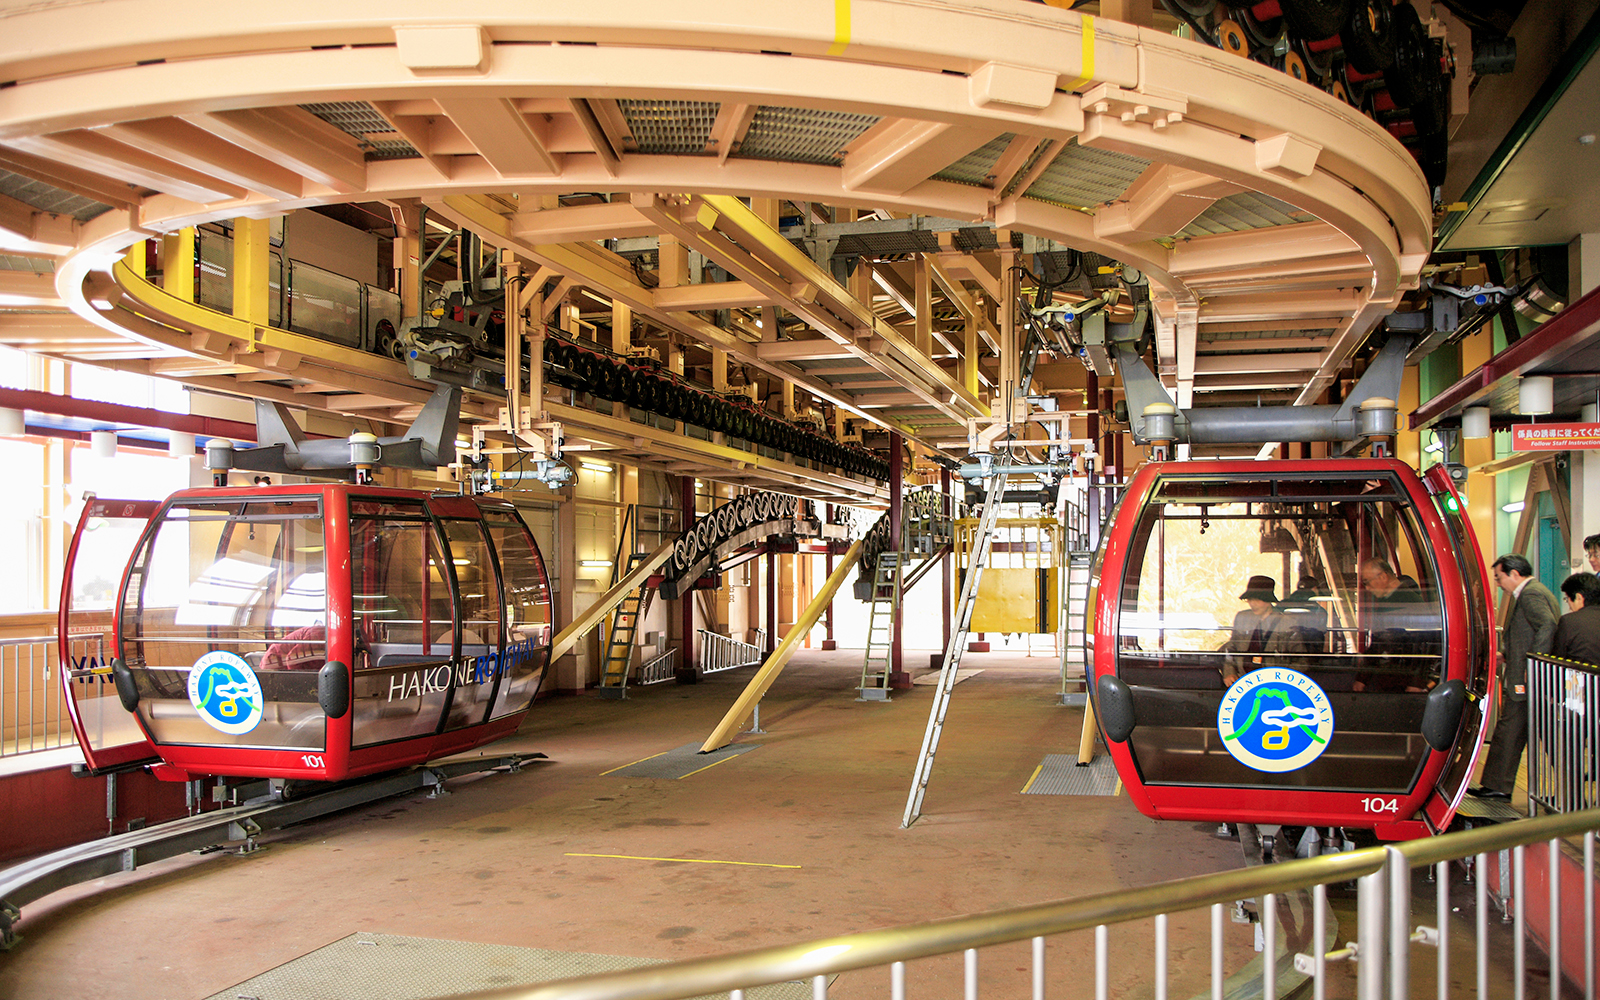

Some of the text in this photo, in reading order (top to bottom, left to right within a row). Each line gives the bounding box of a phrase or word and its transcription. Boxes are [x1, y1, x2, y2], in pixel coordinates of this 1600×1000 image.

[388, 657, 476, 703] HAKONE
[1222, 671, 1330, 725] HAKONE ROPEWAY
[301, 754, 326, 768] 101
[1360, 797, 1399, 813] 104
